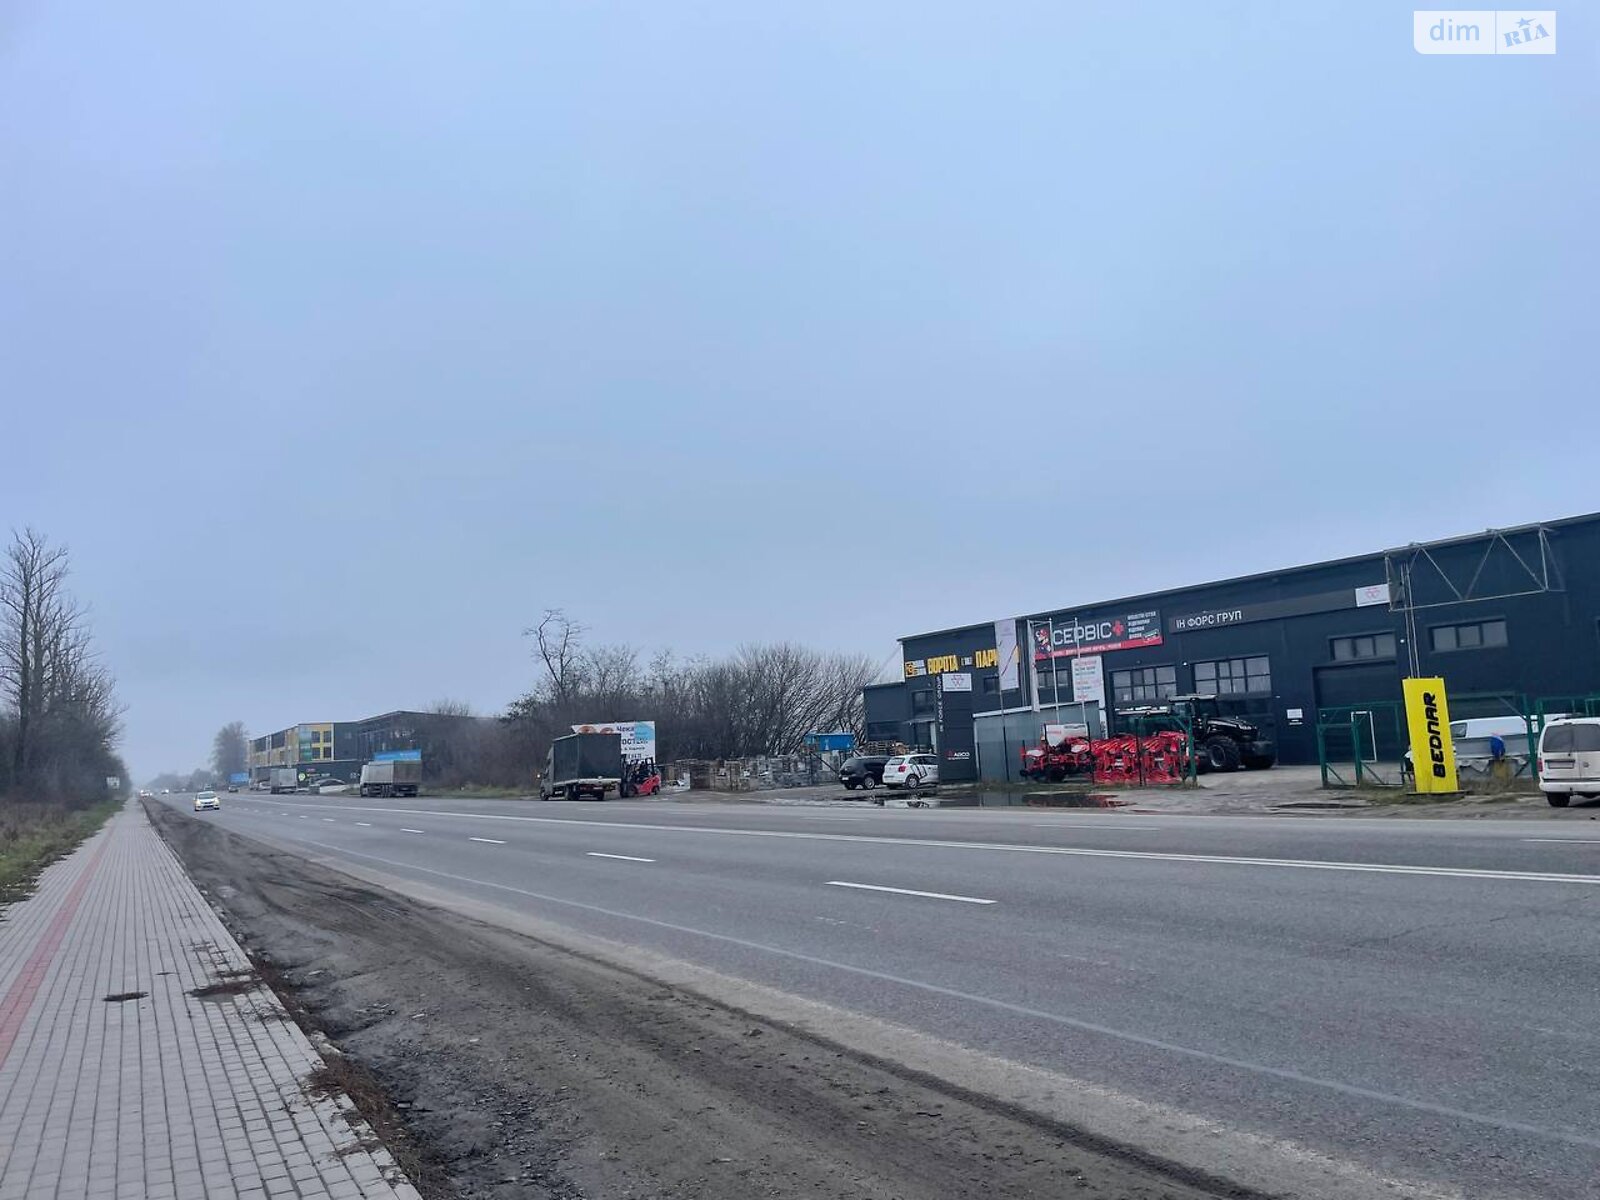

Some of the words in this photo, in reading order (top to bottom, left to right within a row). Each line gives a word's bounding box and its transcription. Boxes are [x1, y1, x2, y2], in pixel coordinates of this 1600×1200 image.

[1187, 614, 1215, 627] ФОРС
[1216, 610, 1242, 624] ГРУП
[1423, 691, 1447, 778] BEDNAR
